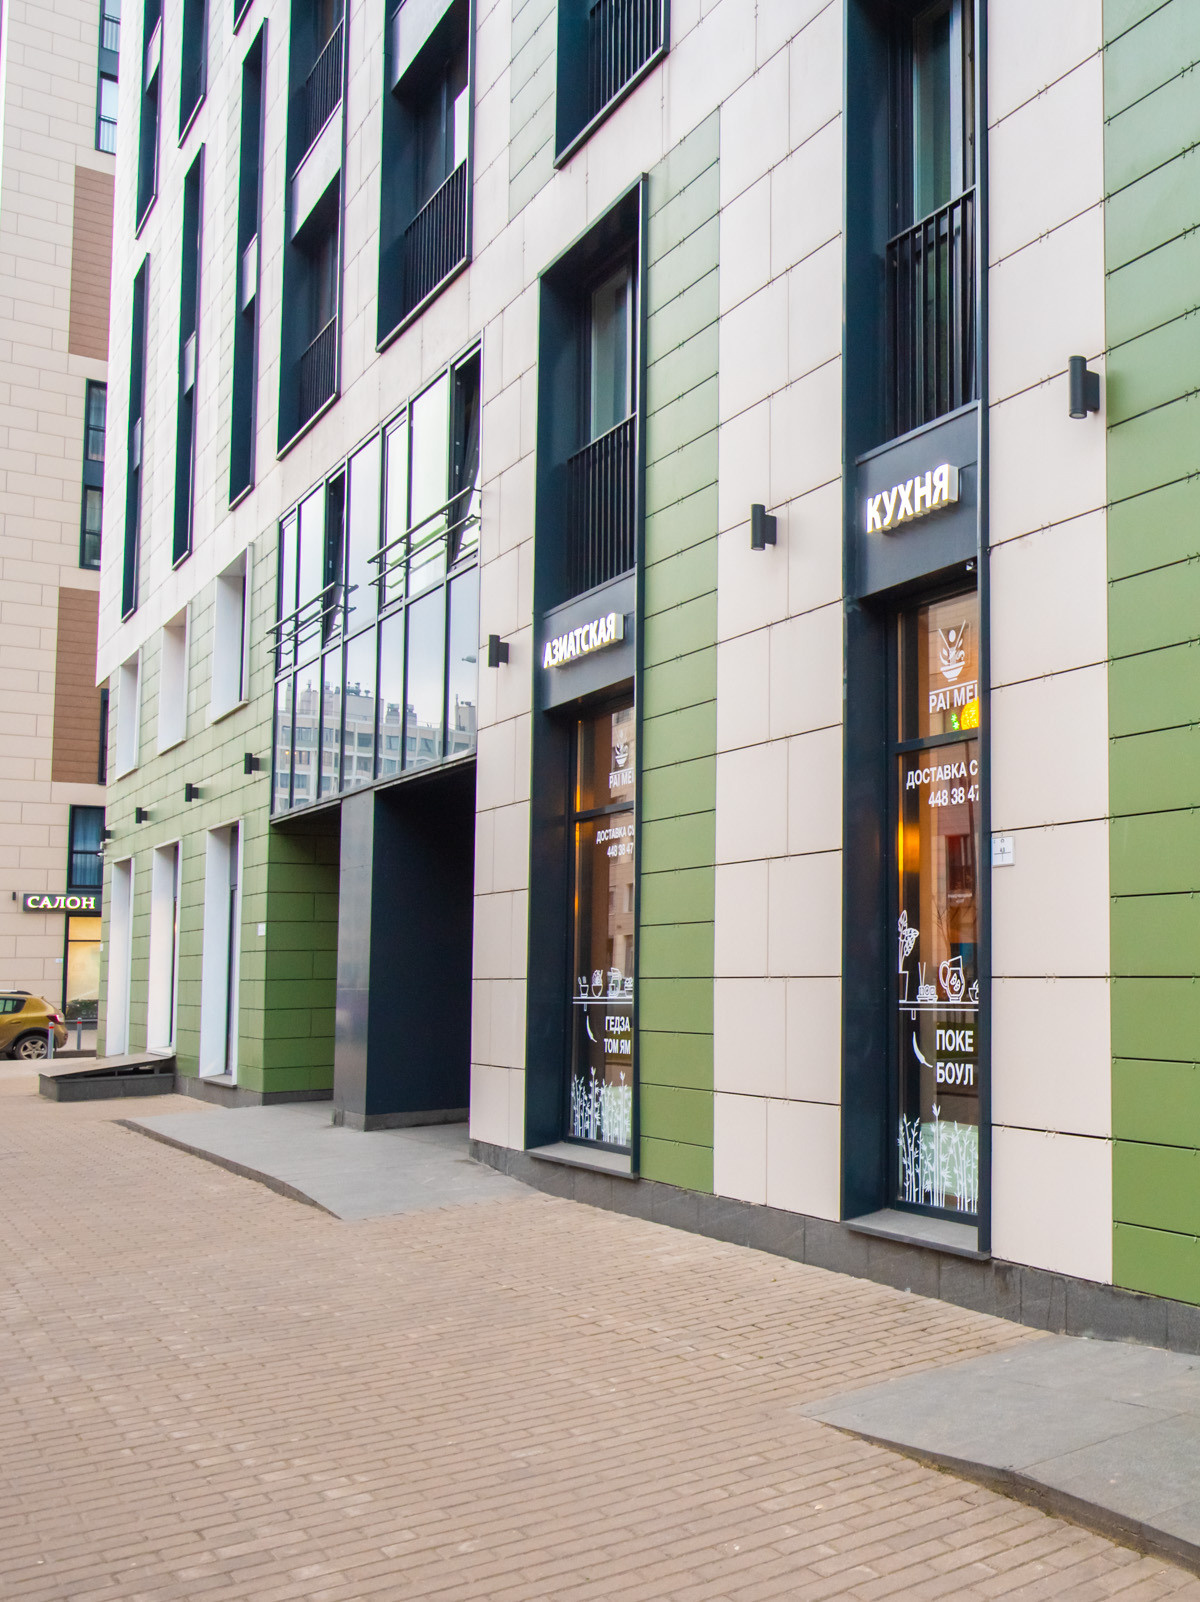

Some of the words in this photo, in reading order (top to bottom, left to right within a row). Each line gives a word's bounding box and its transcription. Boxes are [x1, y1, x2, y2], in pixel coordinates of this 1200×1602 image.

[866, 463, 953, 533] КУХНЯ
[543, 612, 619, 668] АЗИАТСКАЯ
[929, 690, 950, 713] PAI
[954, 684, 978, 707] MEI
[609, 773, 620, 789] PAI
[906, 762, 967, 790] ДОСТАВКА
[928, 790, 949, 807] 448
[951, 787, 965, 805] 38
[967, 785, 979, 802] 47
[596, 826, 627, 844] ДОСТАВКА
[626, 842, 634, 854] 47
[27, 896, 95, 909] САЛОН
[605, 1016, 630, 1034] ГЕДЗА
[604, 1038, 618, 1054] ТОМ
[619, 1039, 631, 1055] ЯМ
[936, 1029, 974, 1052] ПОКЕ
[936, 1062, 974, 1085] БОУЛ
